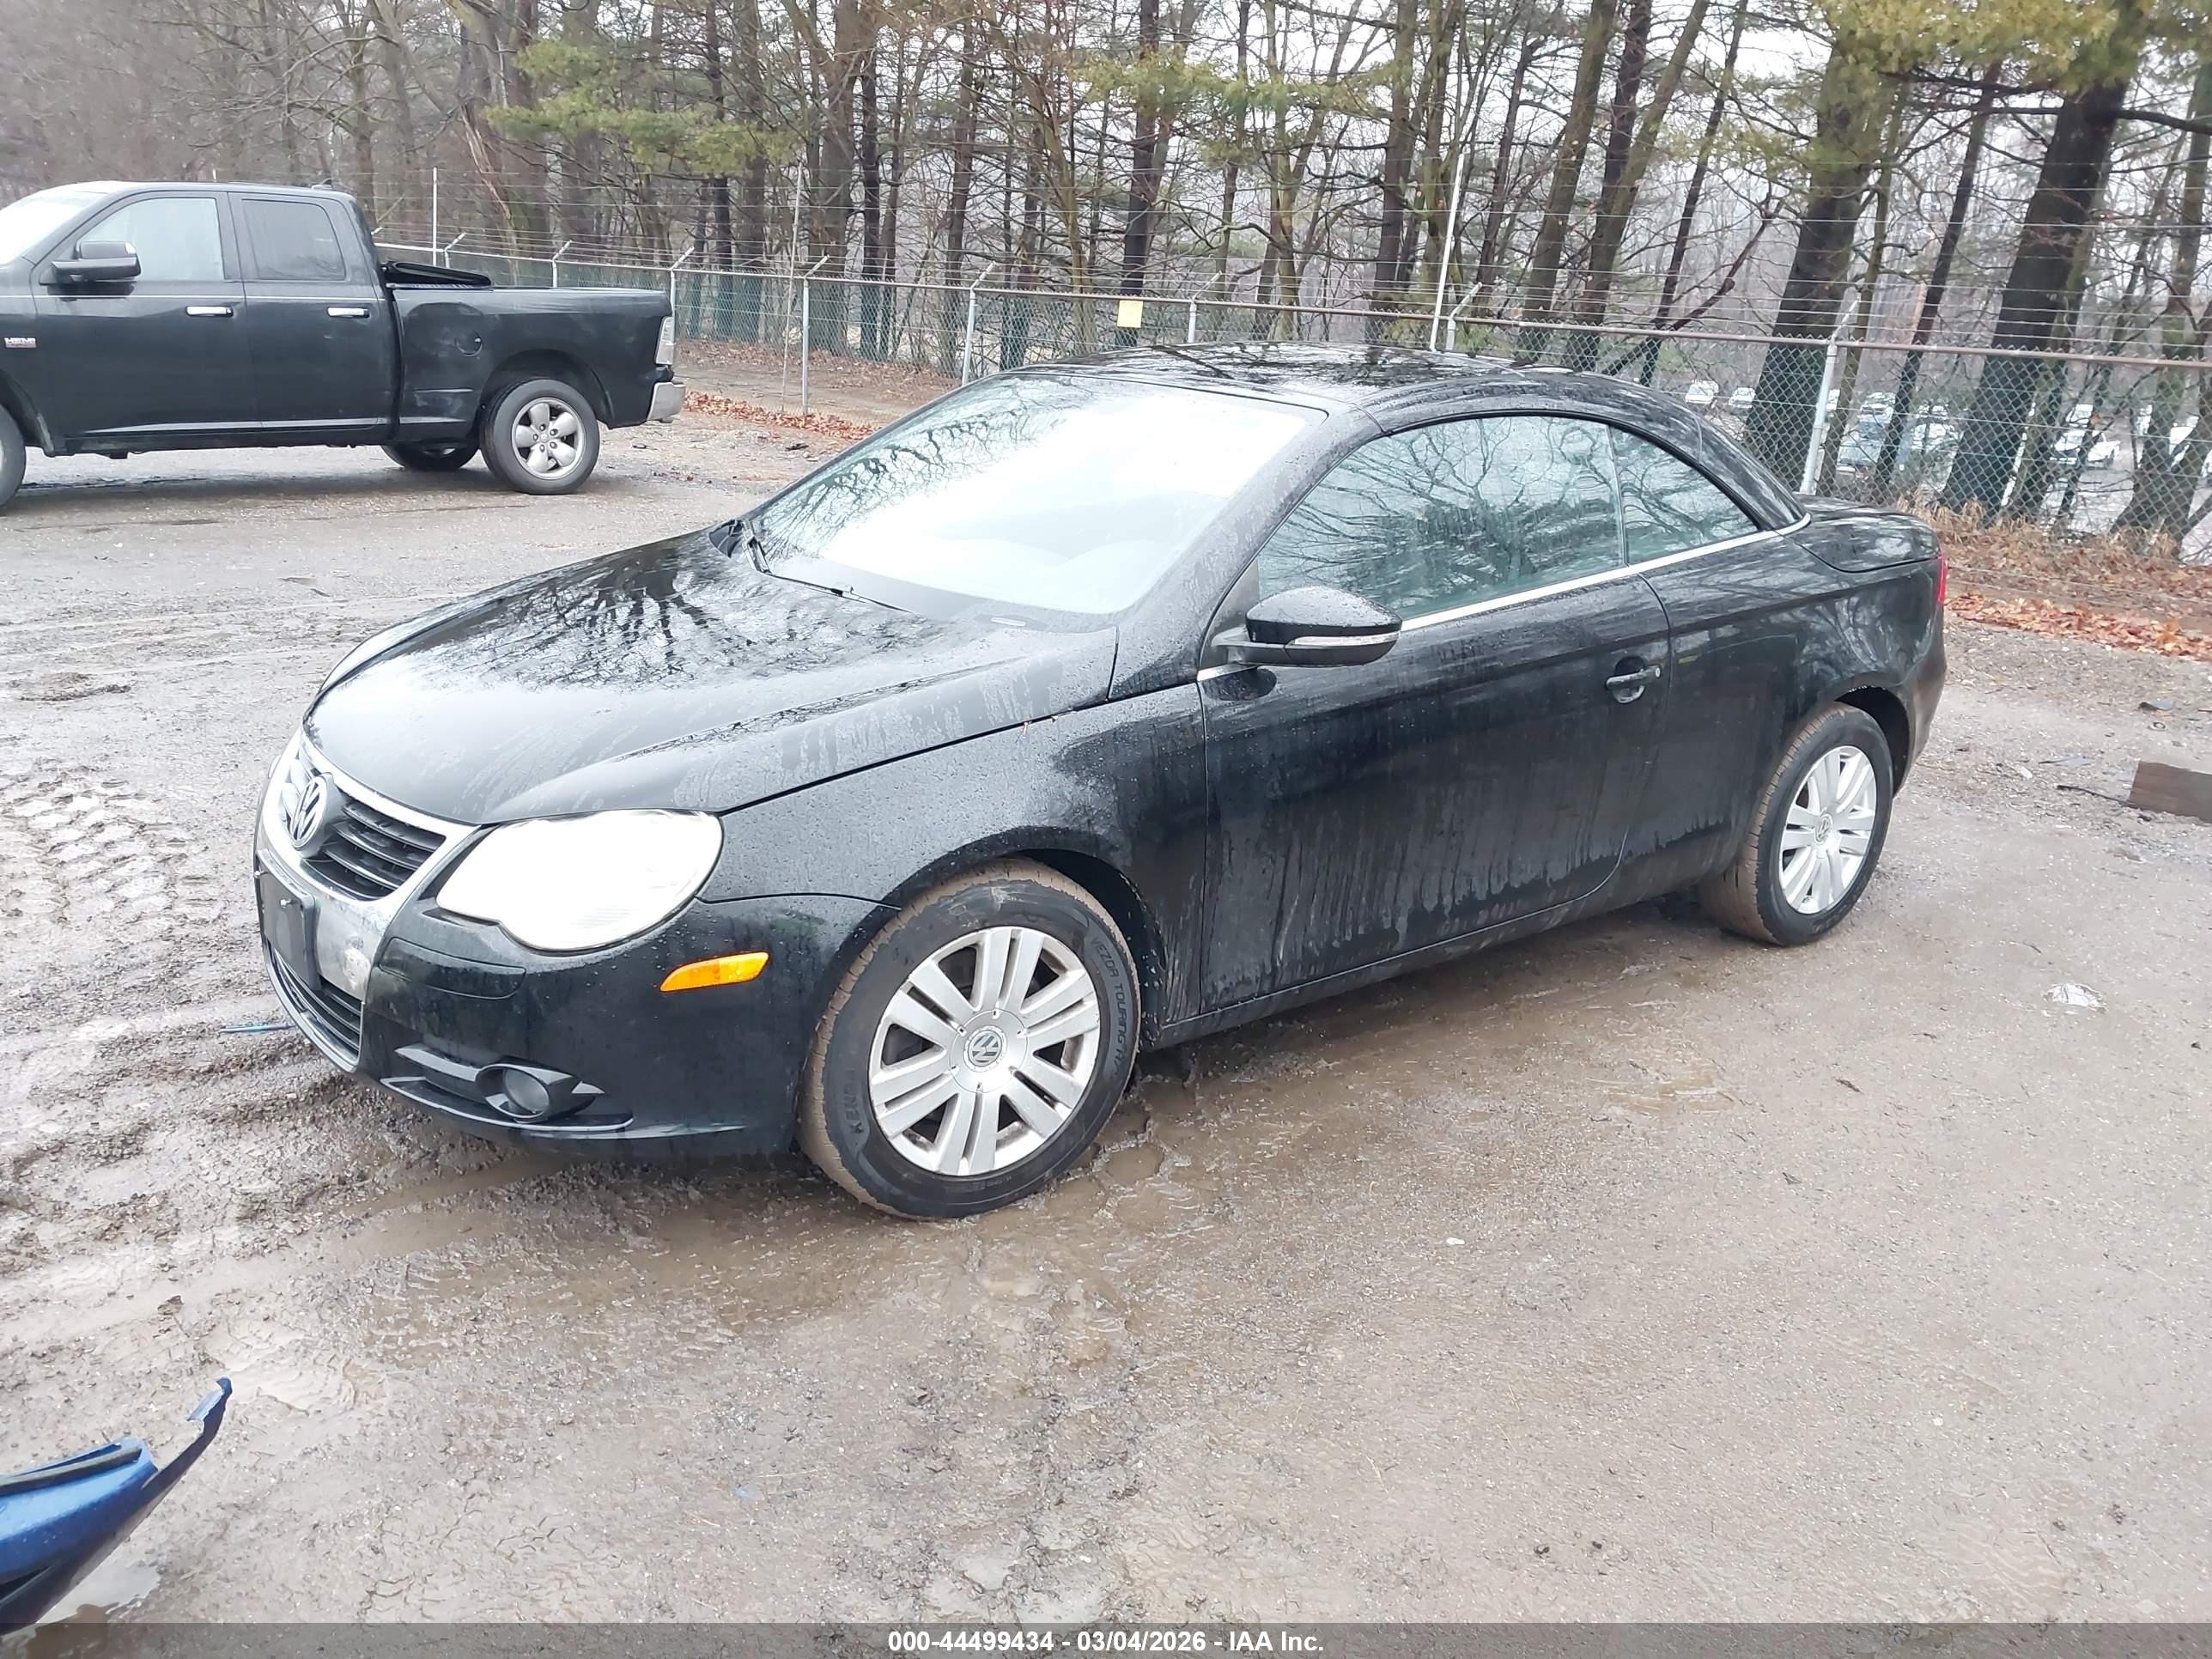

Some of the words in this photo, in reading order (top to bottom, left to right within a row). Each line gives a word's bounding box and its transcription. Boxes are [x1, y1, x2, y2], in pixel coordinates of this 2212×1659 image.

[290, 775, 327, 849] VW
[1114, 981, 1127, 1044] TOURING
[968, 1030, 1003, 1067] VW
